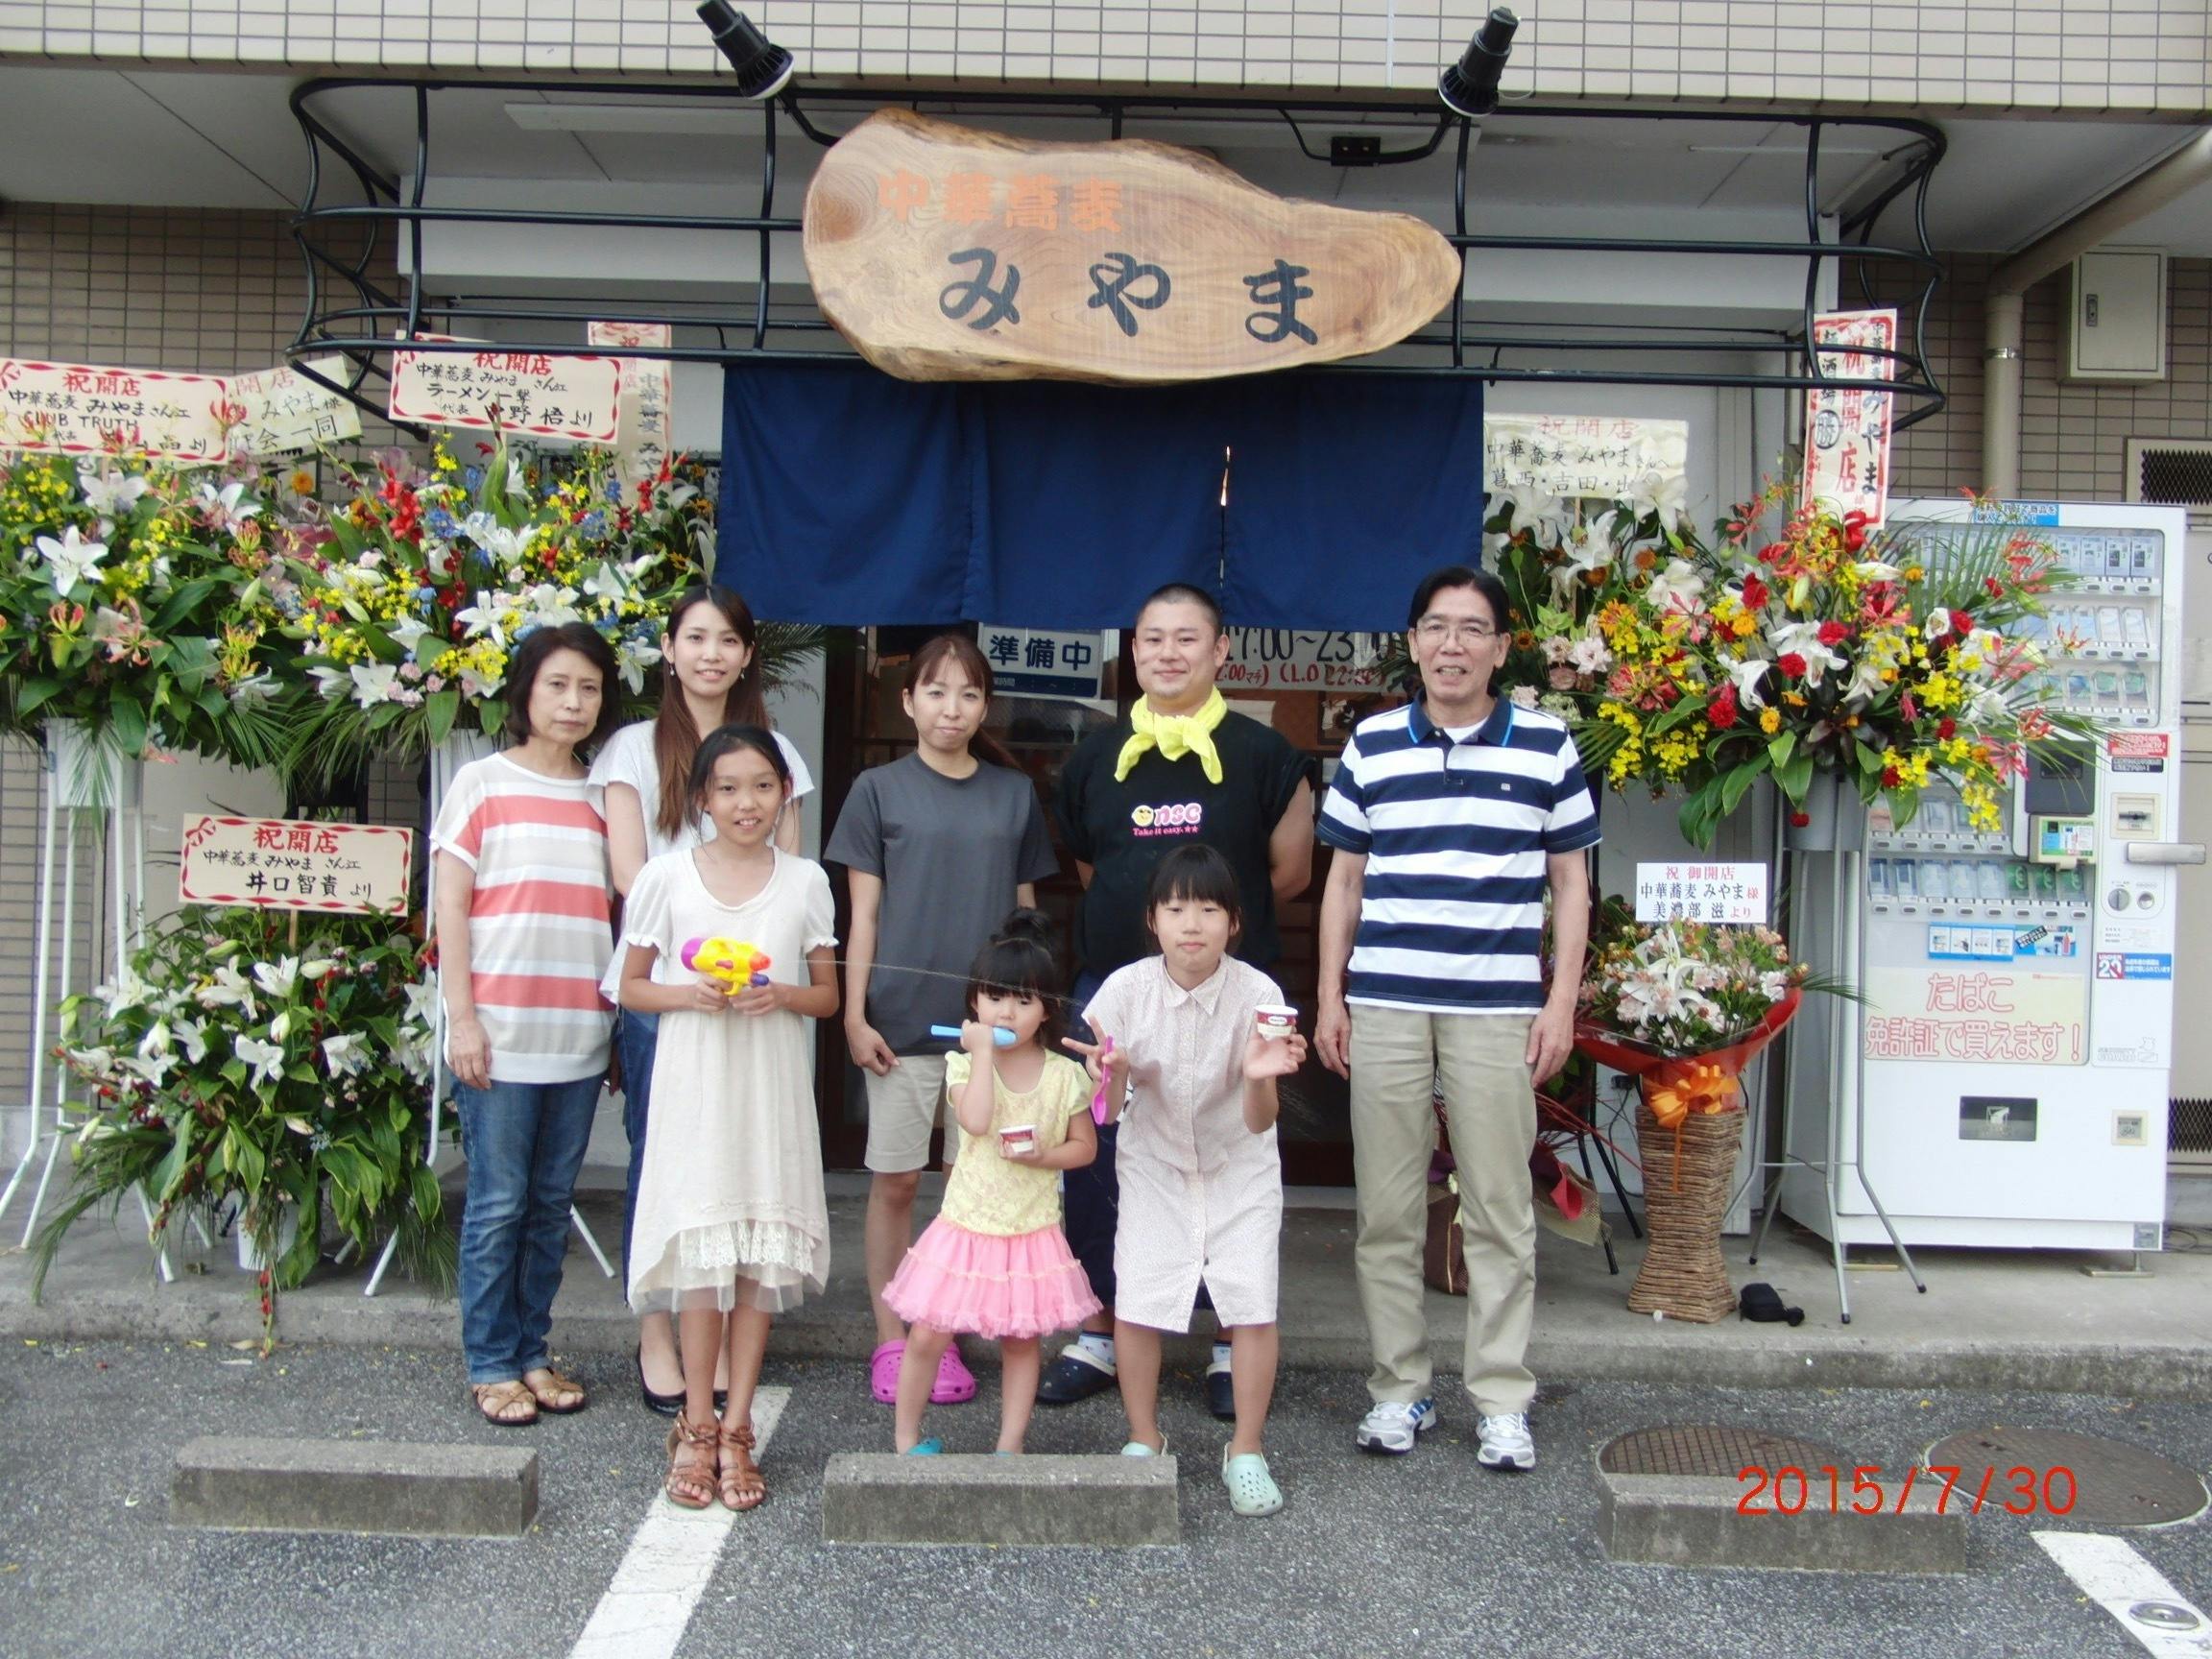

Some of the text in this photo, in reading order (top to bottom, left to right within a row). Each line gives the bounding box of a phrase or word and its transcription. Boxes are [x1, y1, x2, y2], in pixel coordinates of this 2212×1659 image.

[878, 169, 1123, 233] 中華蕎麦
[939, 247, 1318, 347] みやま
[62, 373, 141, 397] 祝開店
[989, 635, 1092, 671] 準備中
[253, 827, 339, 854] 祝開店
[1641, 882, 1697, 900] 中華蕎麦
[1926, 972, 2015, 1013] たばこ
